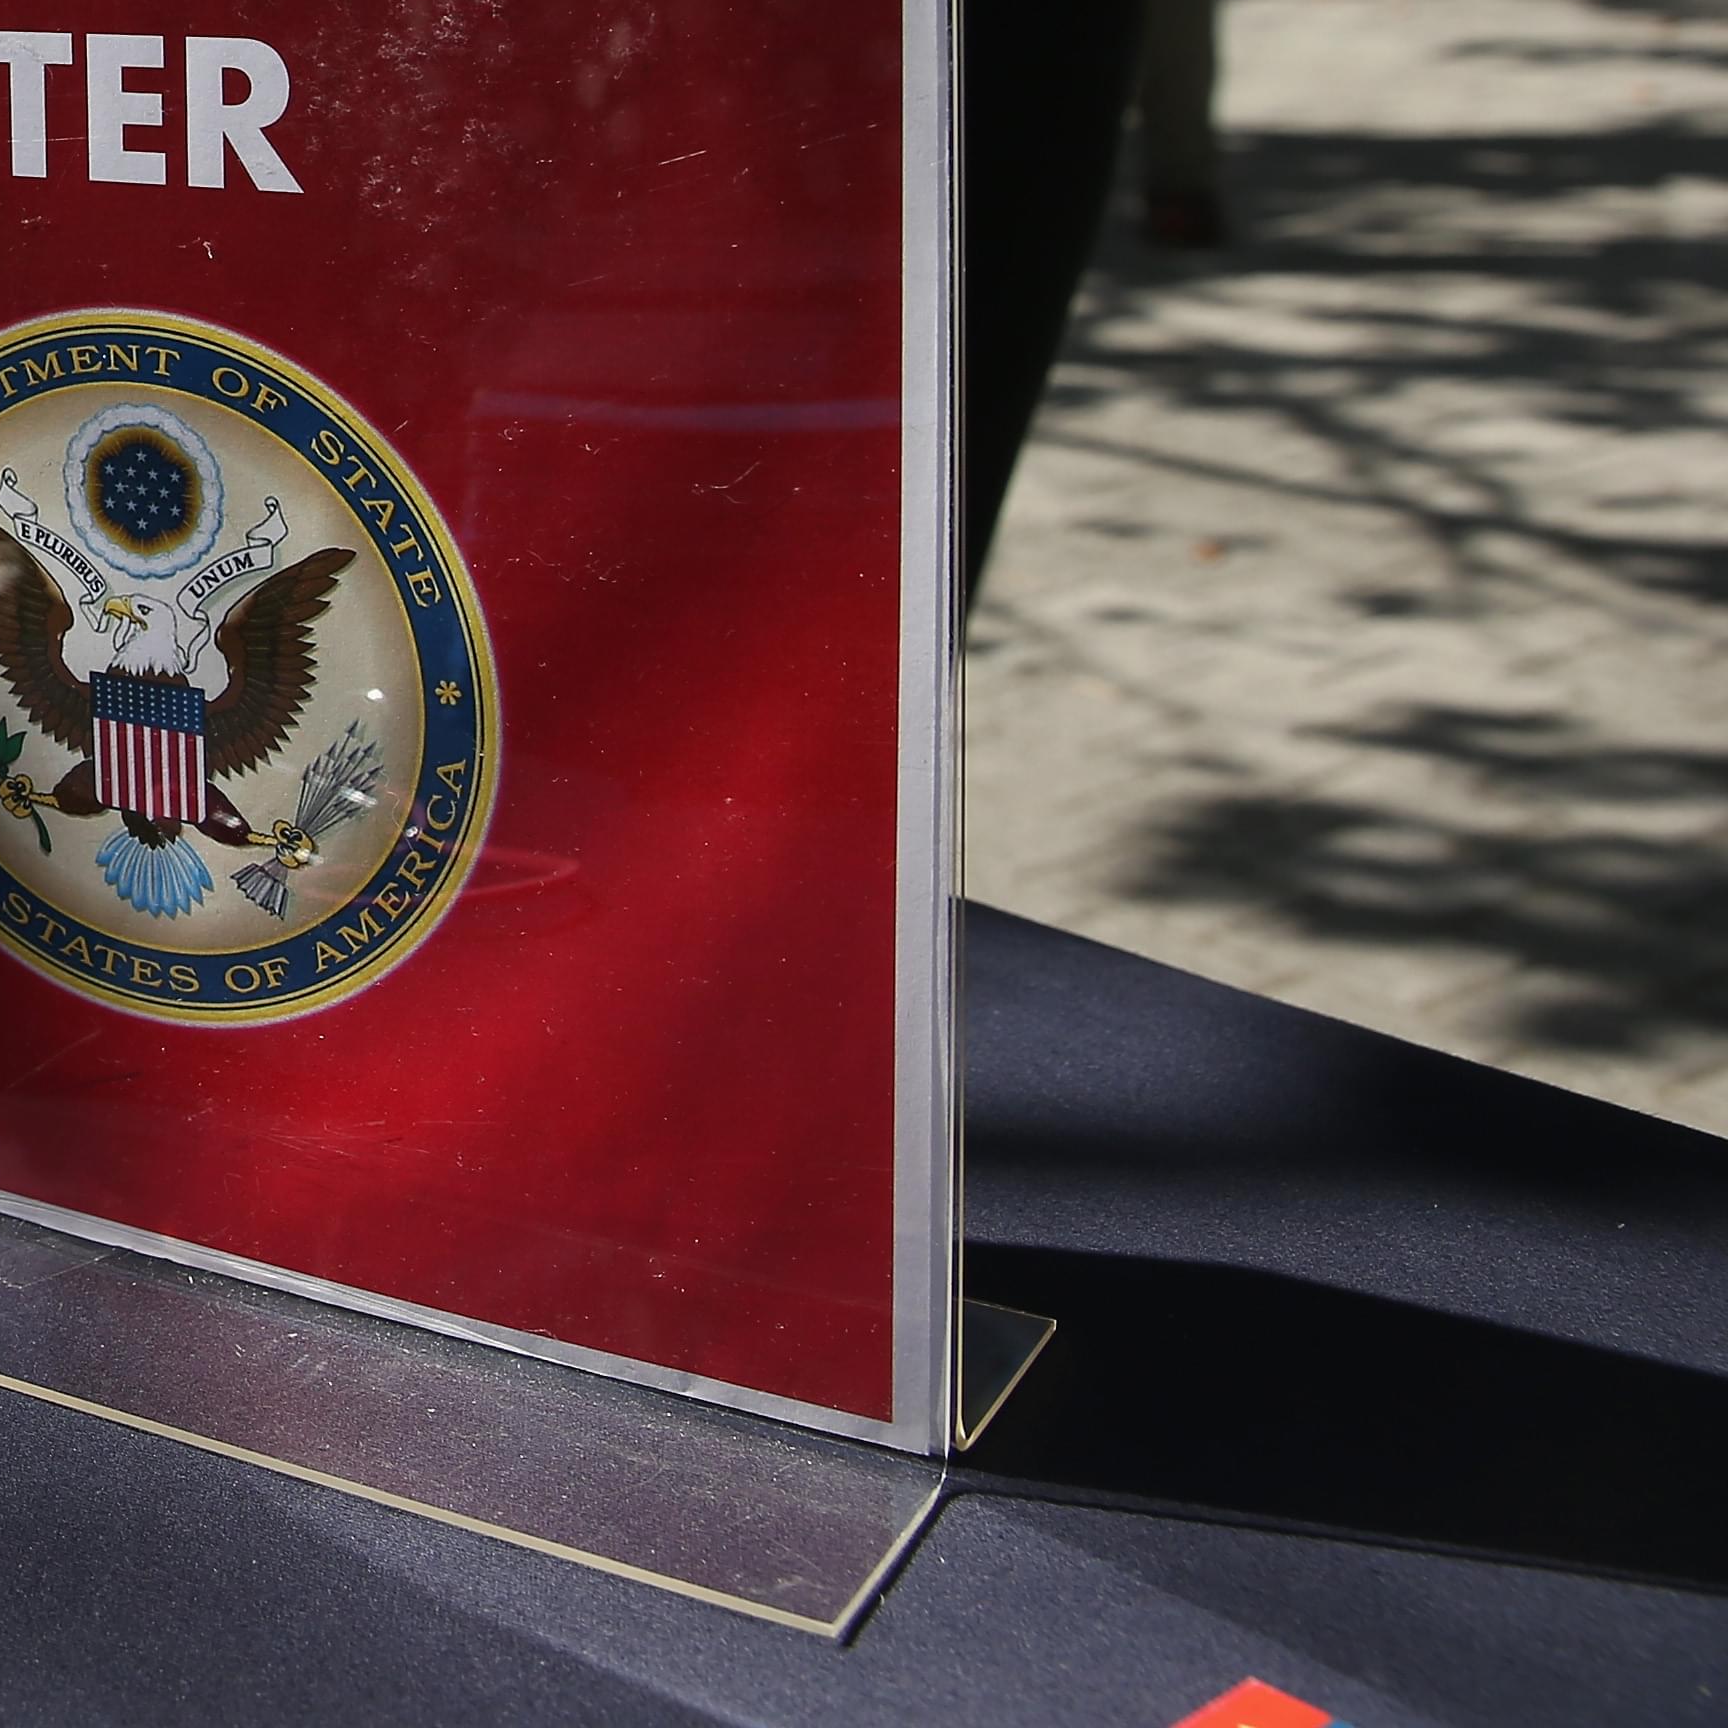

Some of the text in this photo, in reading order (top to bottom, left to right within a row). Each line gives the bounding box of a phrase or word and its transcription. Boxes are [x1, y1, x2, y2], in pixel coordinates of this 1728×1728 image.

[20, 522, 257, 600] E PLURIBUS UNUM
[212, 366, 289, 415] OF
[310, 429, 443, 609] STATE
[1, 892, 202, 994] STATES
[225, 956, 290, 994] OF
[311, 758, 467, 974] AMERICA
